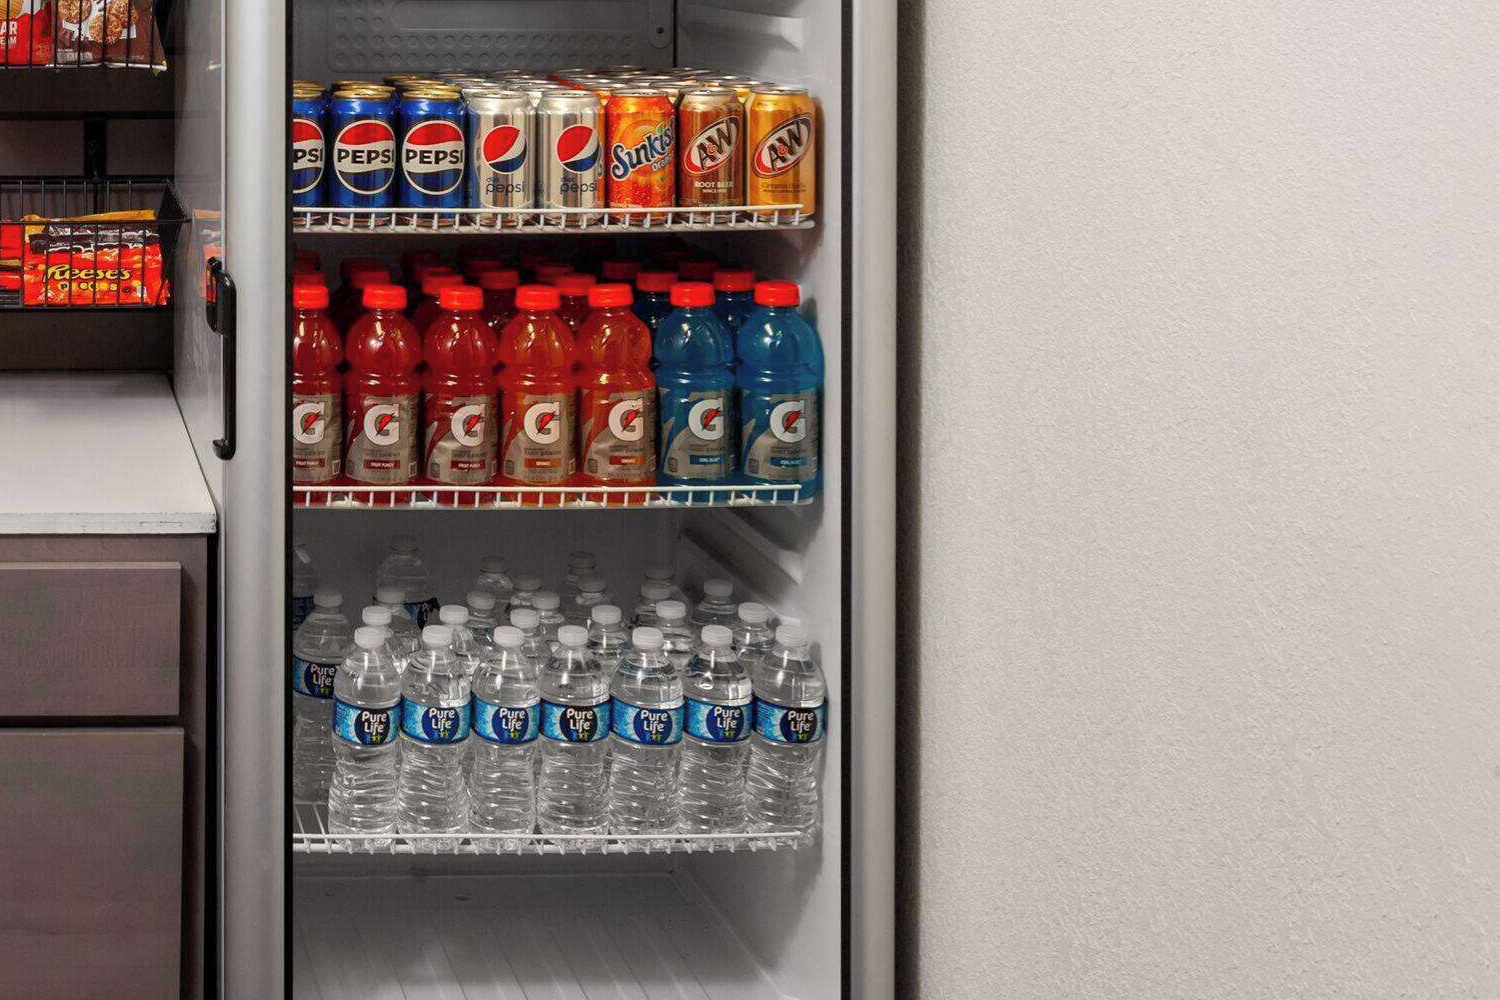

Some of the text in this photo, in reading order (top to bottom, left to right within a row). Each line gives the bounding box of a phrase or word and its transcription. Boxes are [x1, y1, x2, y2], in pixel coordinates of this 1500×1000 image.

[337, 149, 395, 165] PEPSI
[405, 149, 463, 165] PEPSI
[485, 181, 525, 196] pepsi
[560, 181, 597, 196] pepsi
[46, 264, 132, 280] Reese's
[310, 663, 336, 675] Pure
[312, 674, 334, 686] Life
[361, 711, 387, 724] Pure
[428, 708, 455, 720] Pure
[499, 707, 525, 720] Pure
[566, 708, 593, 721] Pure
[640, 709, 668, 722] Pure
[713, 706, 741, 719] Pure
[787, 710, 814, 722] Pure
[364, 722, 384, 735] Life
[431, 718, 452, 731] Life
[502, 718, 523, 731] Life
[569, 719, 591, 732] Life
[643, 720, 666, 733] Life
[716, 717, 738, 731] Life
[790, 720, 812, 734] Life
